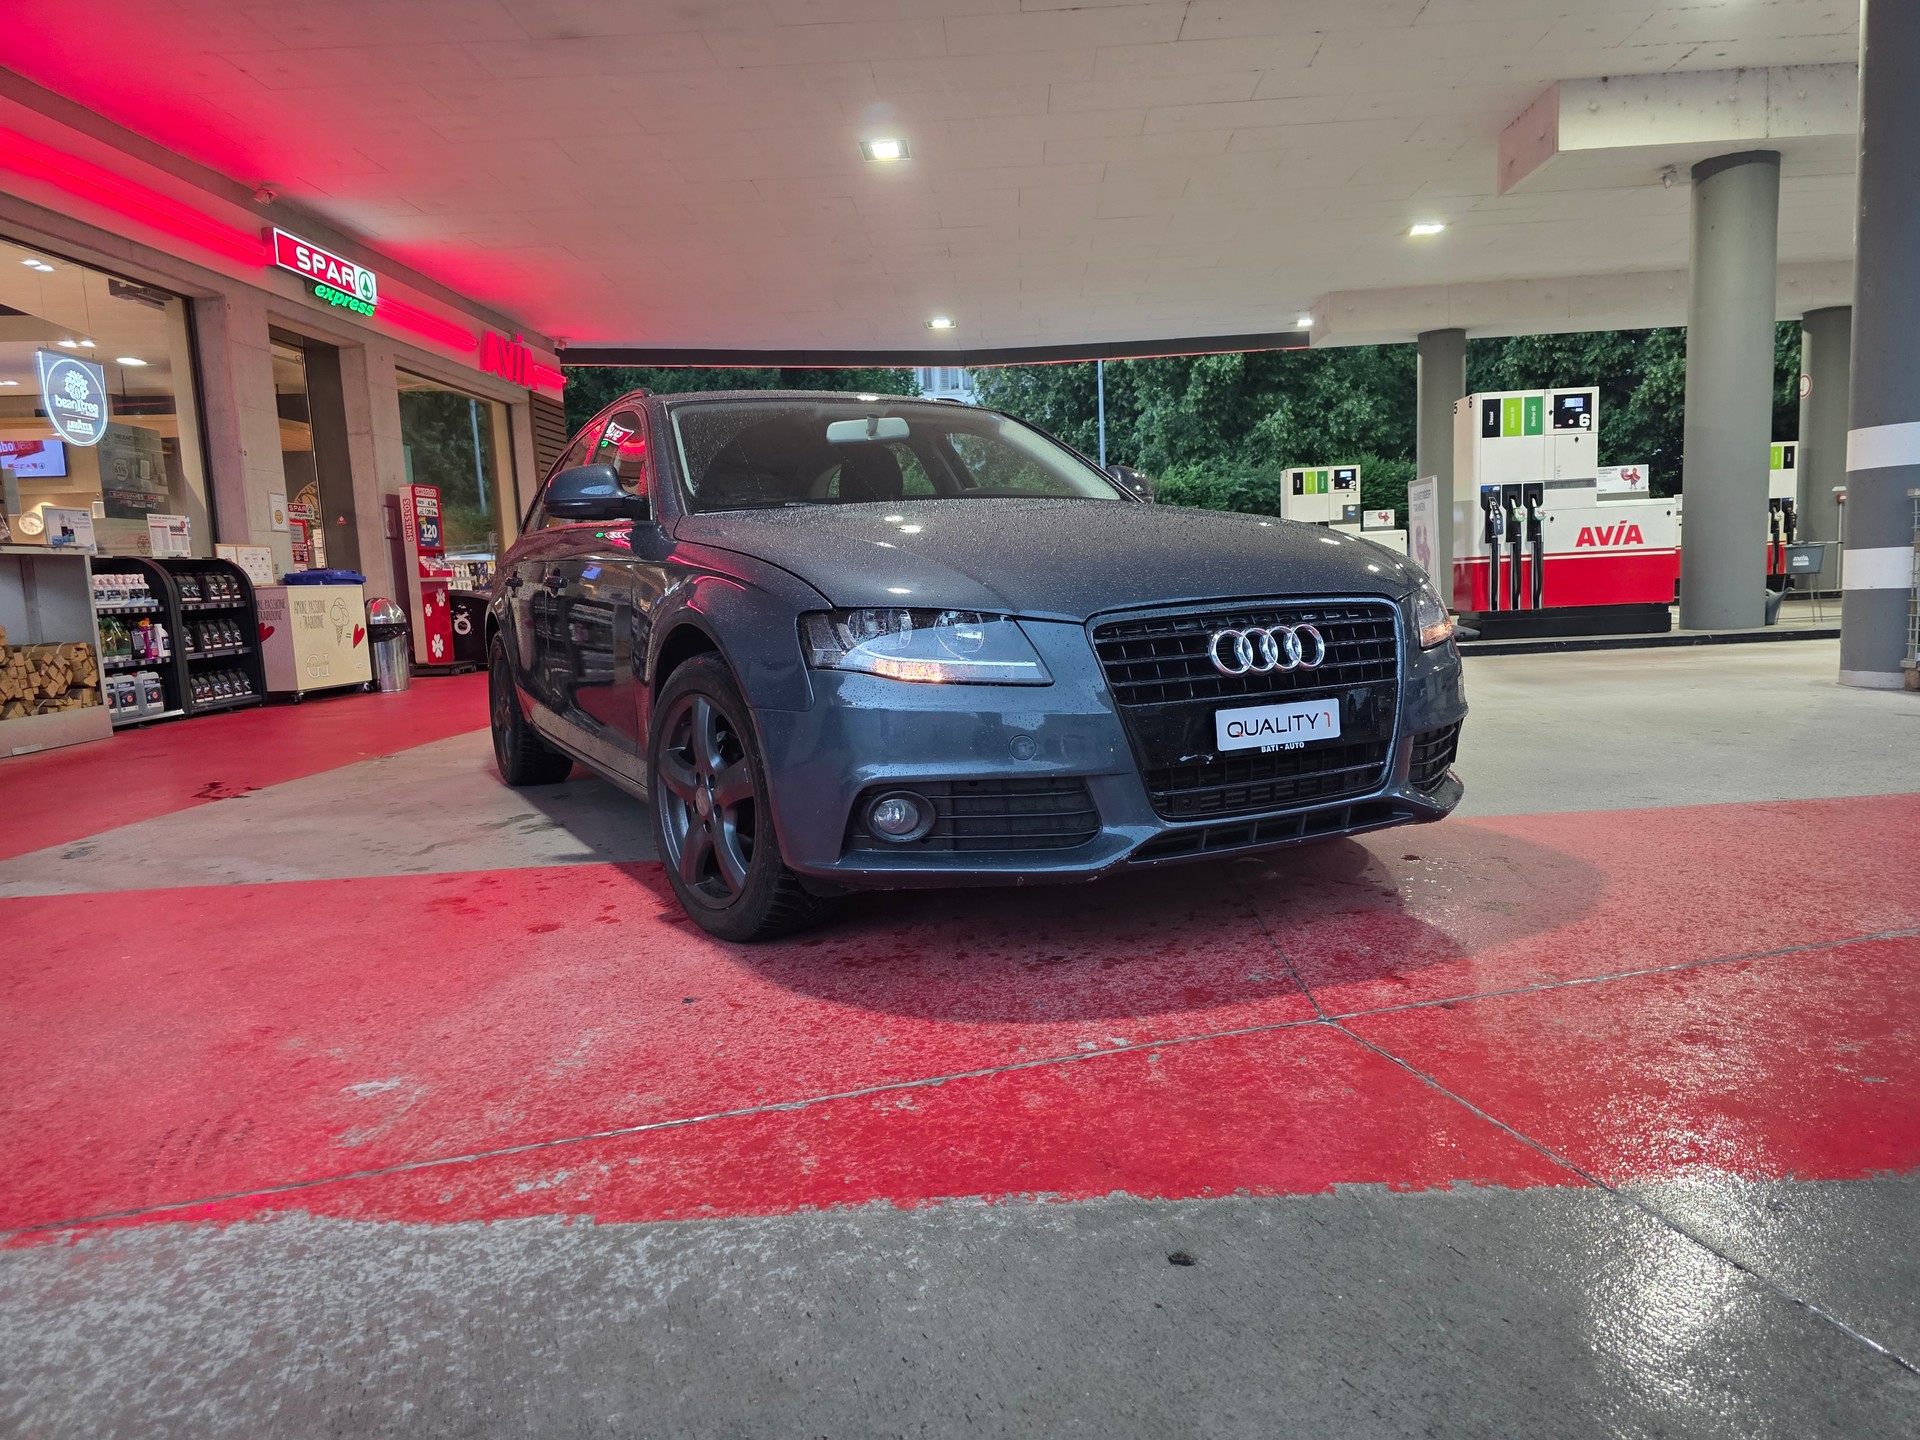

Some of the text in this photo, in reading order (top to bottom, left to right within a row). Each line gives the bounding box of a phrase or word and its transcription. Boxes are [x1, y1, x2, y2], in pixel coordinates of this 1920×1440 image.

[295, 245, 356, 290] SPAR
[314, 283, 374, 317] express
[1578, 413, 1591, 427] 6
[1348, 480, 1356, 489] 2
[288, 504, 308, 513] SPAR
[403, 498, 414, 542] SWISSLOS
[1227, 712, 1331, 738] QUALITY 1
